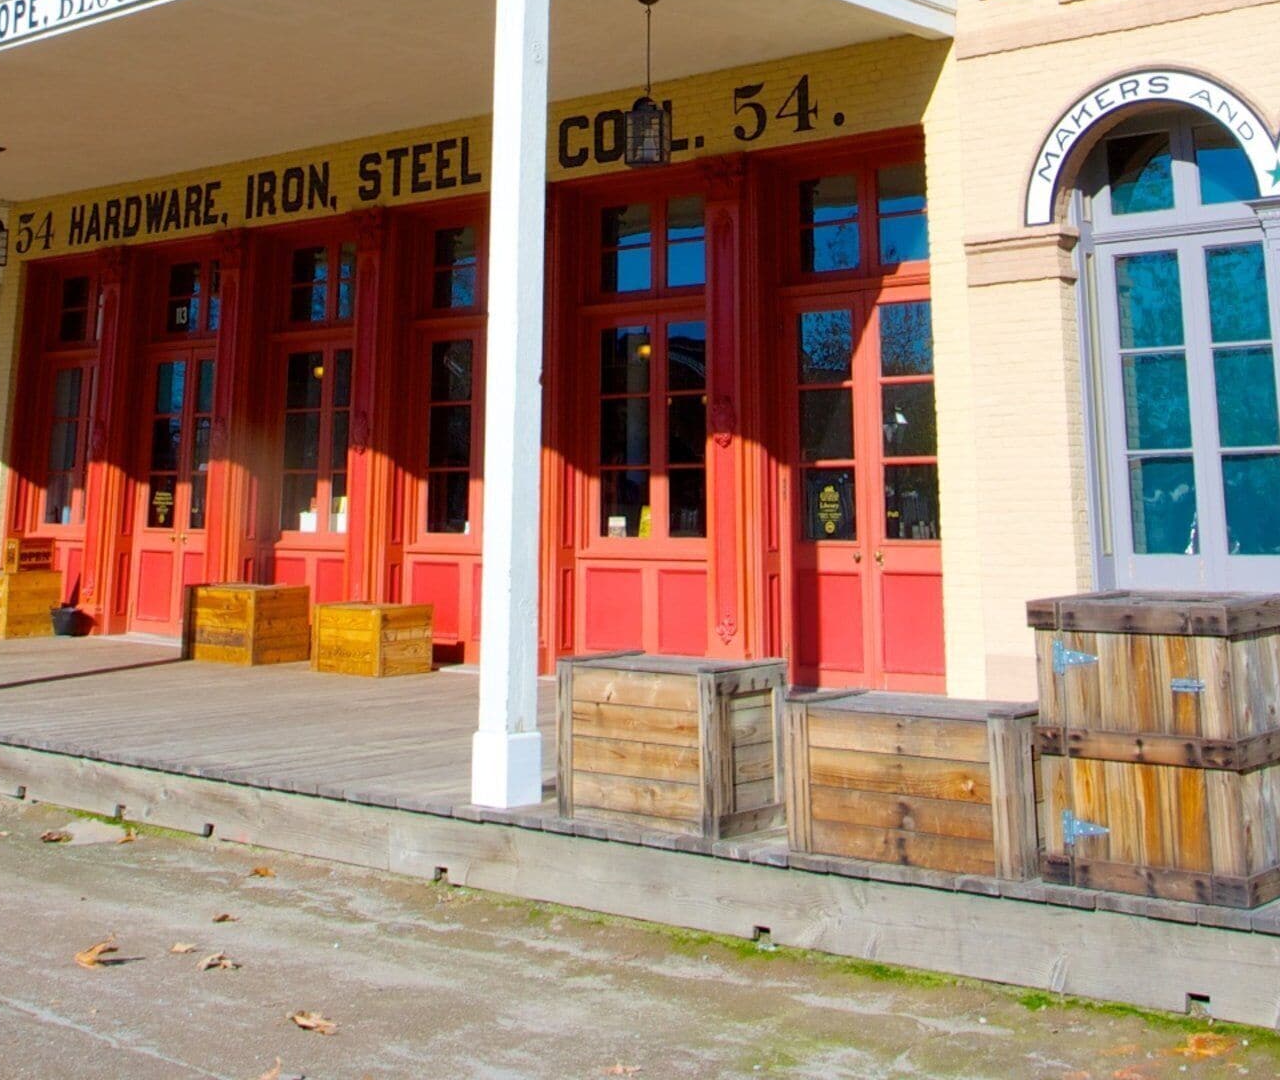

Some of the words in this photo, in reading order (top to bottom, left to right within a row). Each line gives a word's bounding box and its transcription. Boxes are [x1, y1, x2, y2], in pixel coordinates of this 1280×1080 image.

[15, 211, 55, 254] 54
[68, 180, 228, 246] HARDWARE,
[245, 161, 337, 219] IRON,
[358, 136, 482, 201] STEEL
[558, 99, 704, 168] COL.
[733, 74, 845, 141] 54.
[1038, 75, 1169, 183] MAKERS
[1188, 88, 1256, 143] AND
